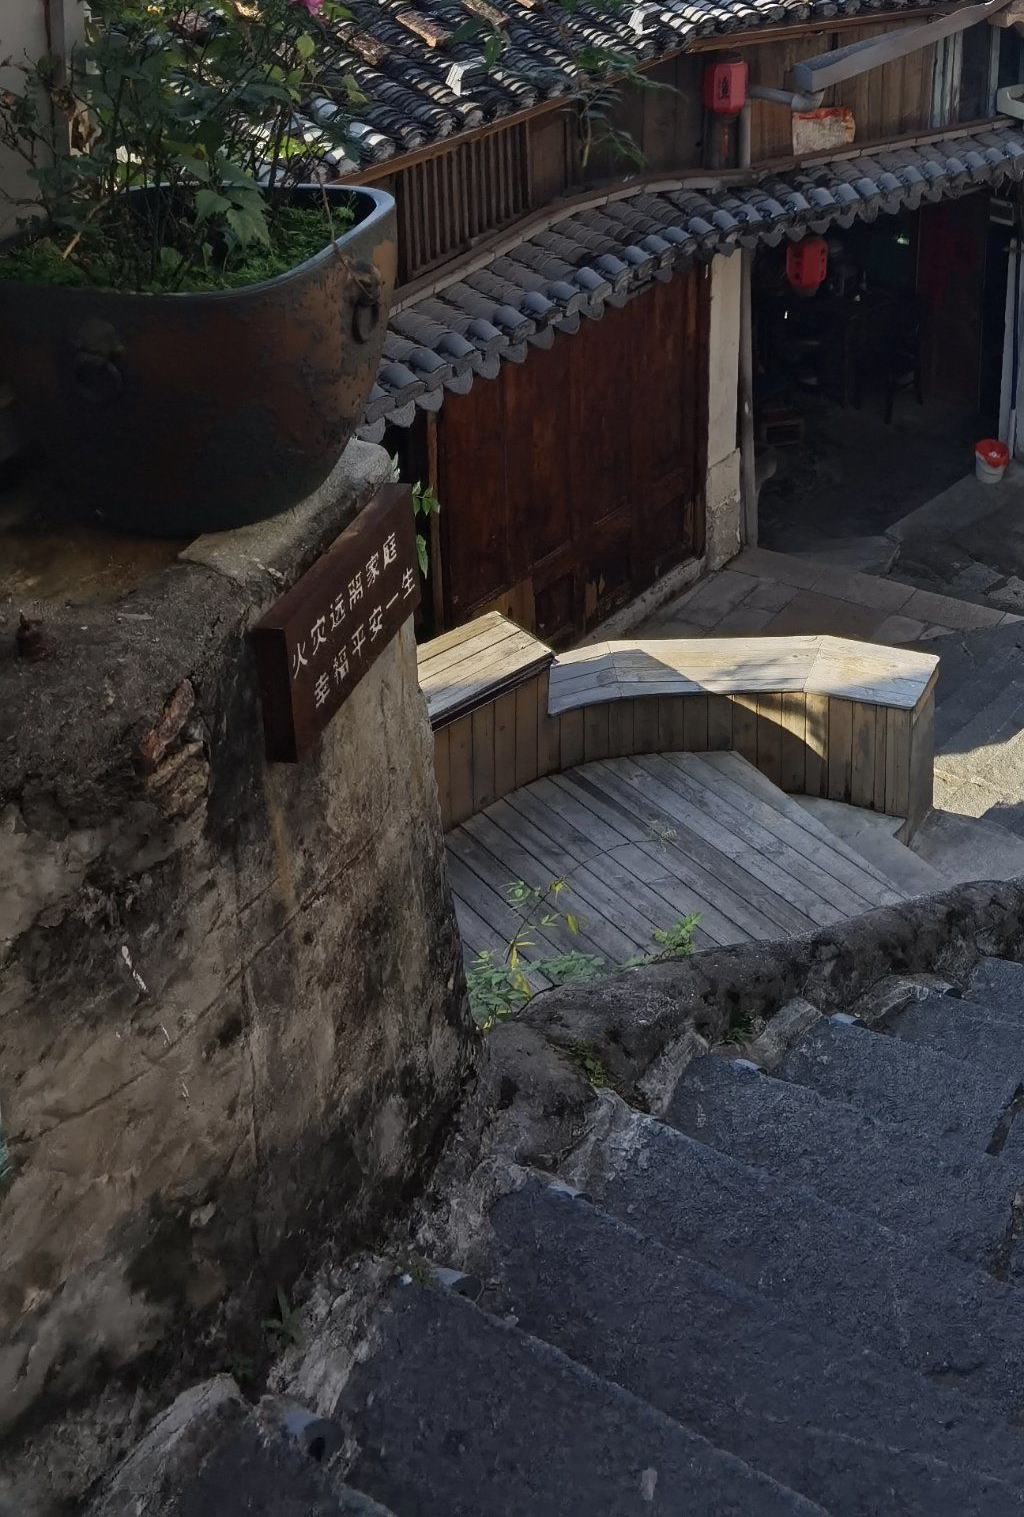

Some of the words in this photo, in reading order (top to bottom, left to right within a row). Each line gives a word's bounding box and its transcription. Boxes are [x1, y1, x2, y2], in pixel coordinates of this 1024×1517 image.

[291, 531, 398, 680] 火灾远离家庭
[313, 567, 417, 710] 幸福平安一生
